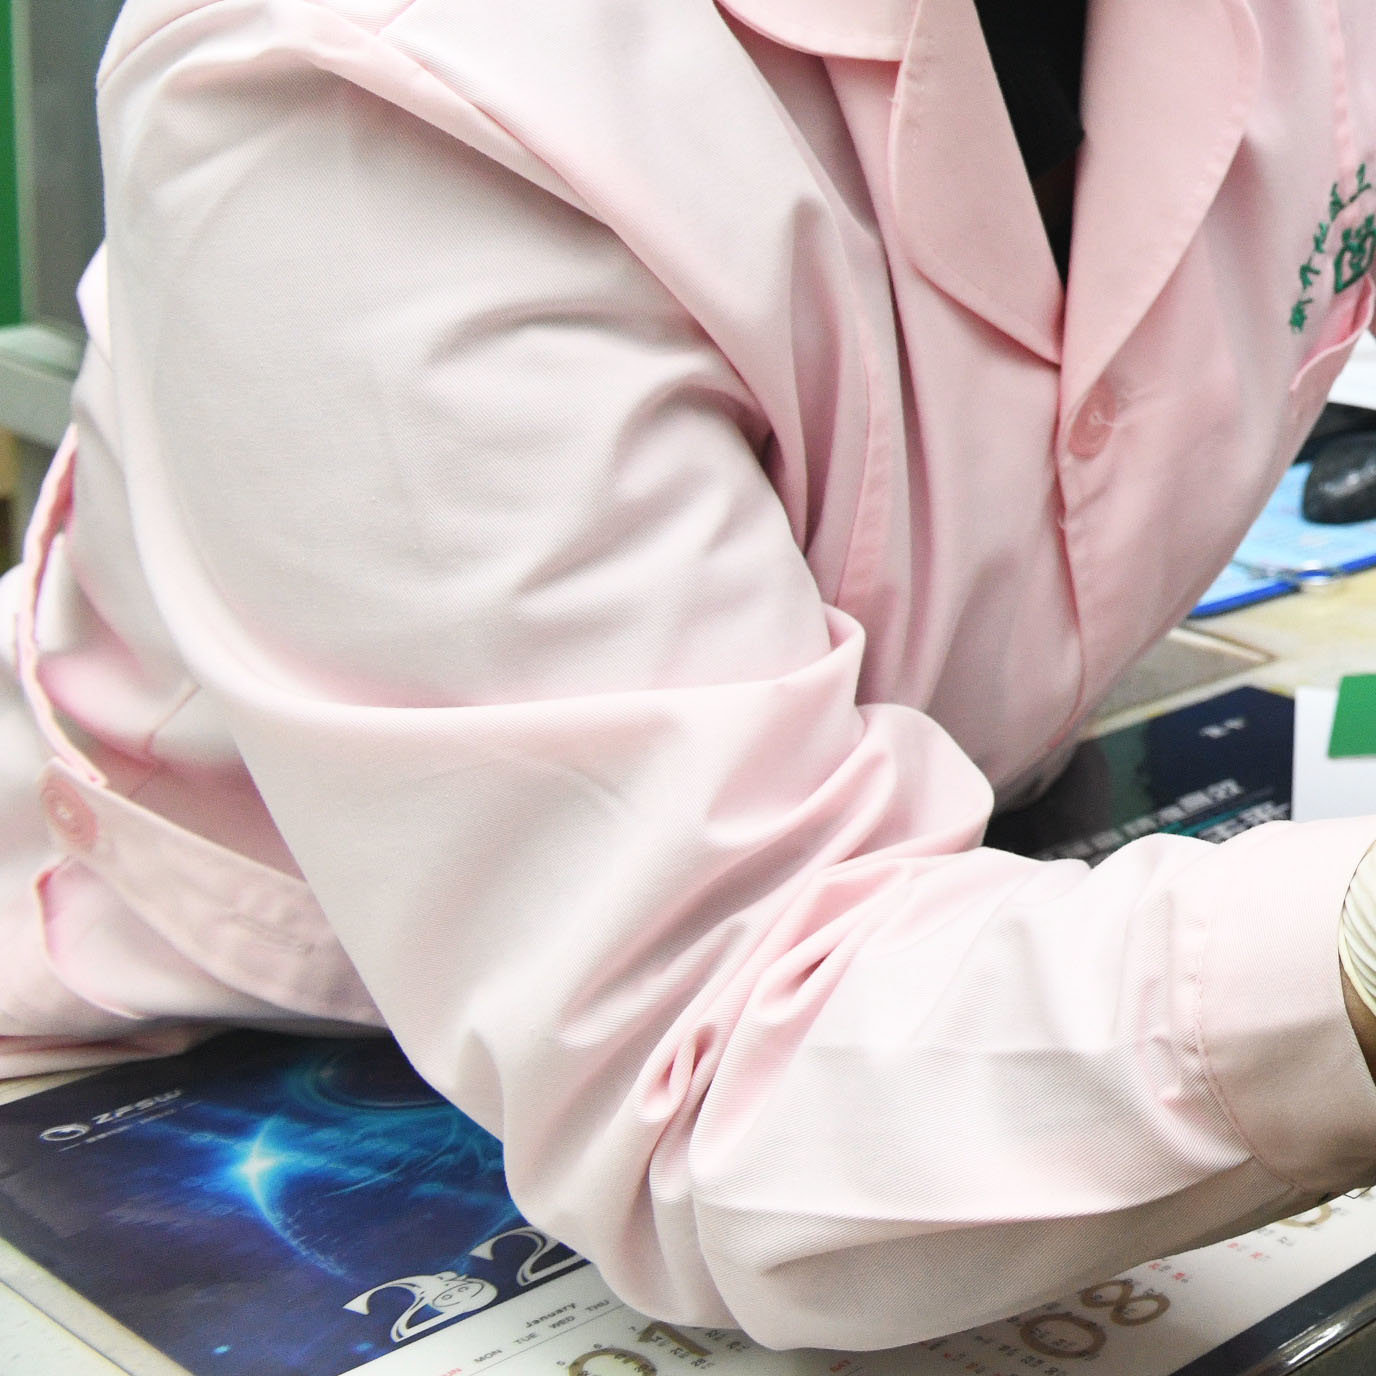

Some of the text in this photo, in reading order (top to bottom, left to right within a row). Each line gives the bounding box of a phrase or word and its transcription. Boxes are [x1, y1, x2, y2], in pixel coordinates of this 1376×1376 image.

[473, 1298, 610, 1363] MON TUE WED THU
[525, 1302, 577, 1328] January
